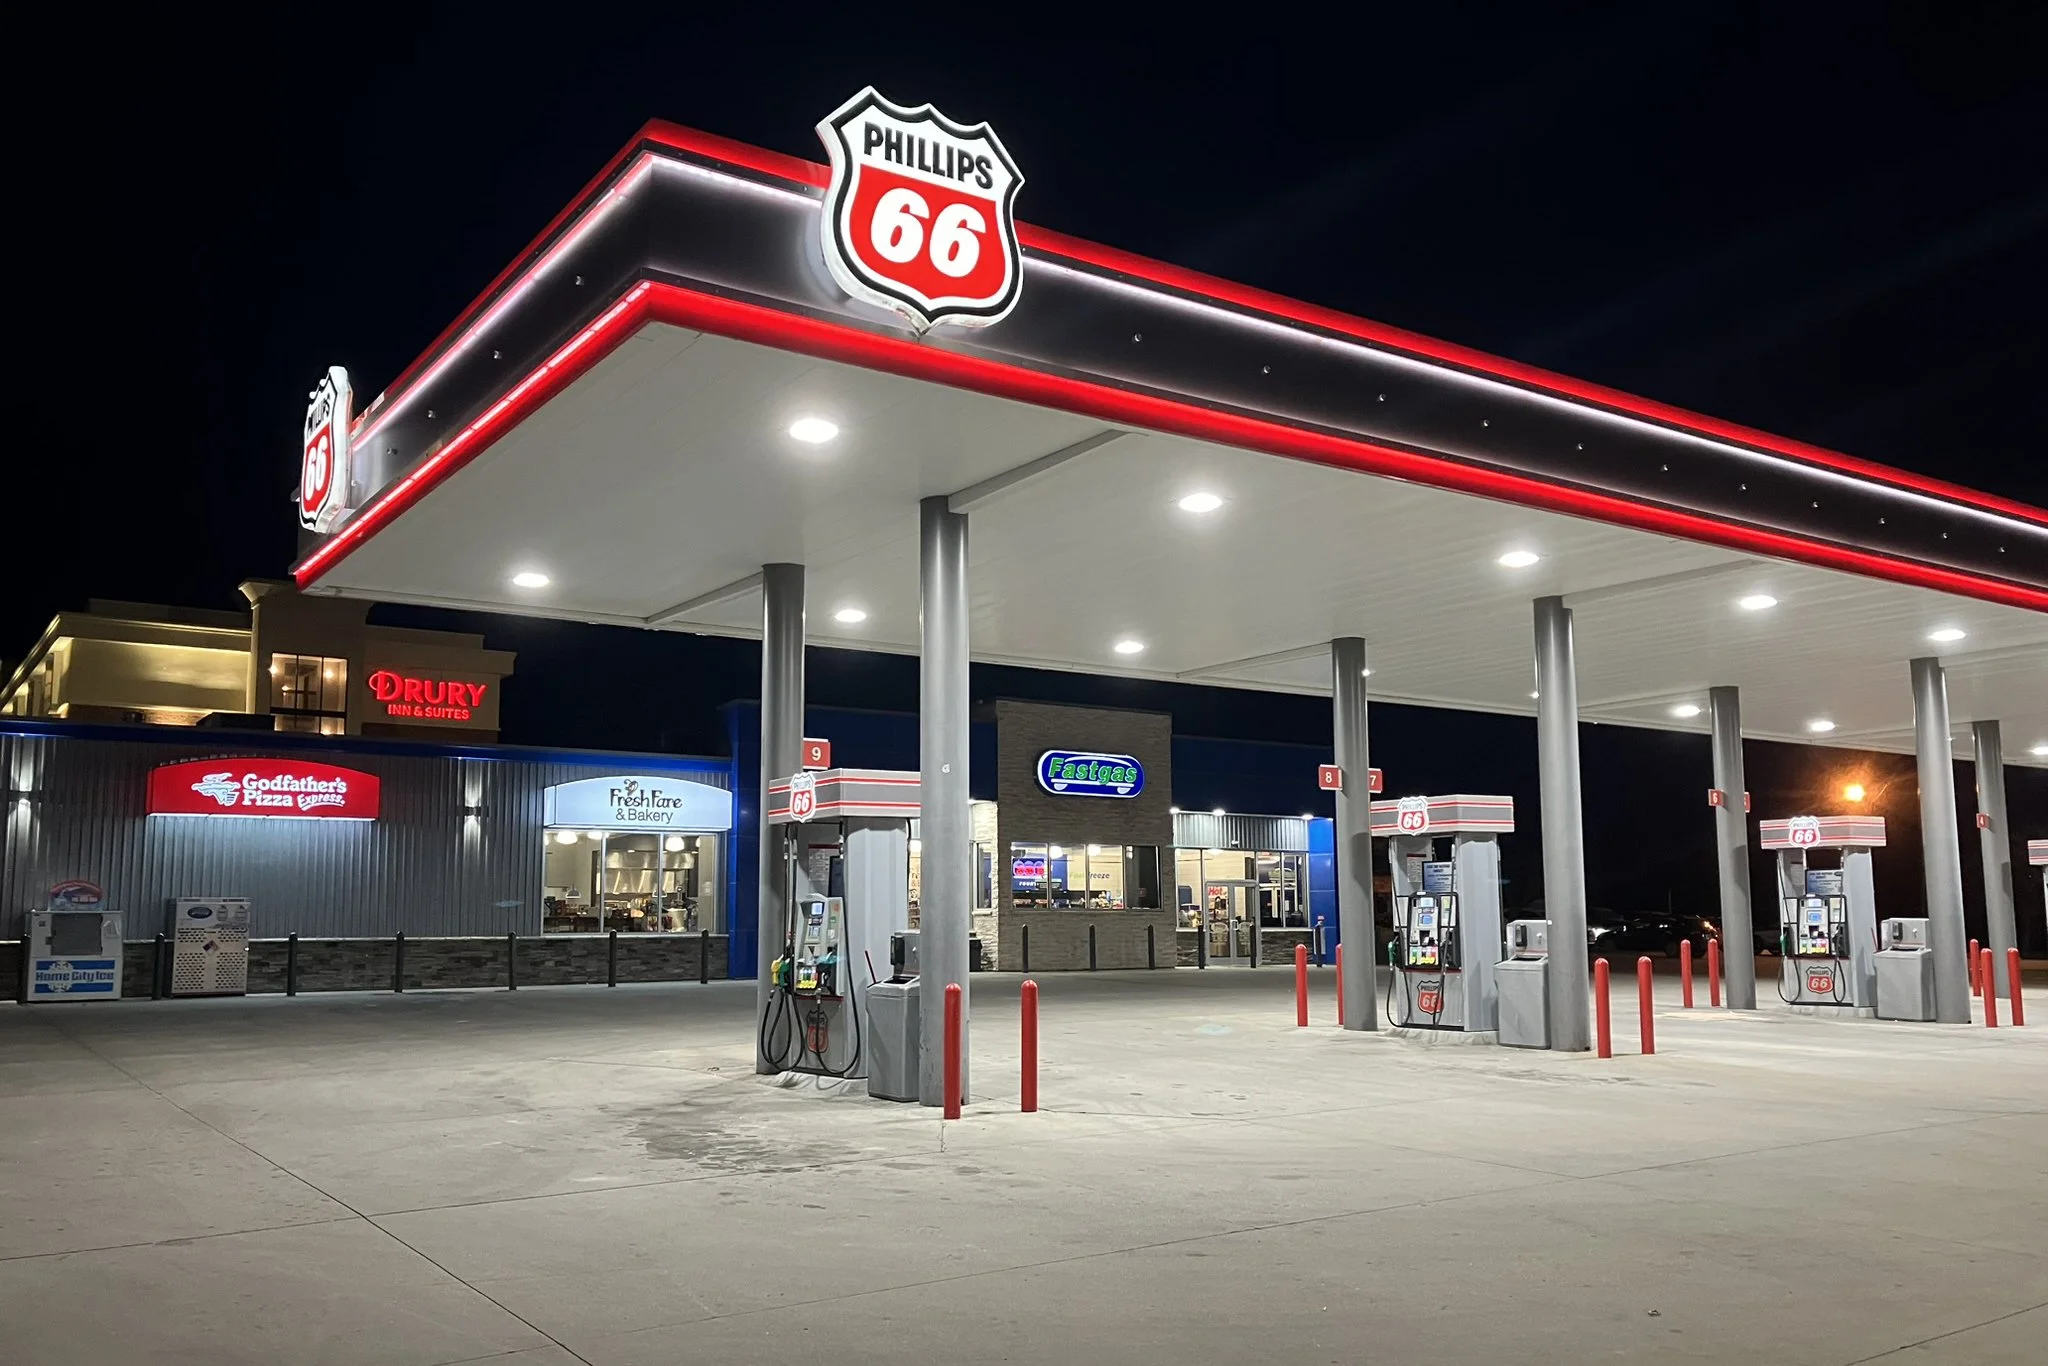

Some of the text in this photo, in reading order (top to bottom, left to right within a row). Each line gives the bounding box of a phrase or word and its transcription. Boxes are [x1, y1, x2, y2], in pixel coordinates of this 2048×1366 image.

[863, 121, 994, 190] PHILLIPS
[870, 187, 987, 278] 66
[305, 435, 328, 501] 66
[368, 670, 487, 708] DRURY
[388, 703, 470, 720] INN & SUITES
[811, 746, 822, 761] 9
[1047, 757, 1138, 785] Fastgas
[1325, 771, 1333, 784] 8
[242, 773, 348, 794] Godfather's
[1369, 775, 1377, 787] 7
[241, 788, 294, 807] Pizza
[609, 788, 684, 809] Fresh Fare
[793, 791, 811, 814] 66
[1712, 792, 1719, 804] 6
[615, 808, 674, 825] & Bakery
[1402, 811, 1423, 829] 66
[1794, 830, 1814, 844] 66
[36, 970, 115, 984] Home City Ice
[1811, 977, 1829, 989] 66
